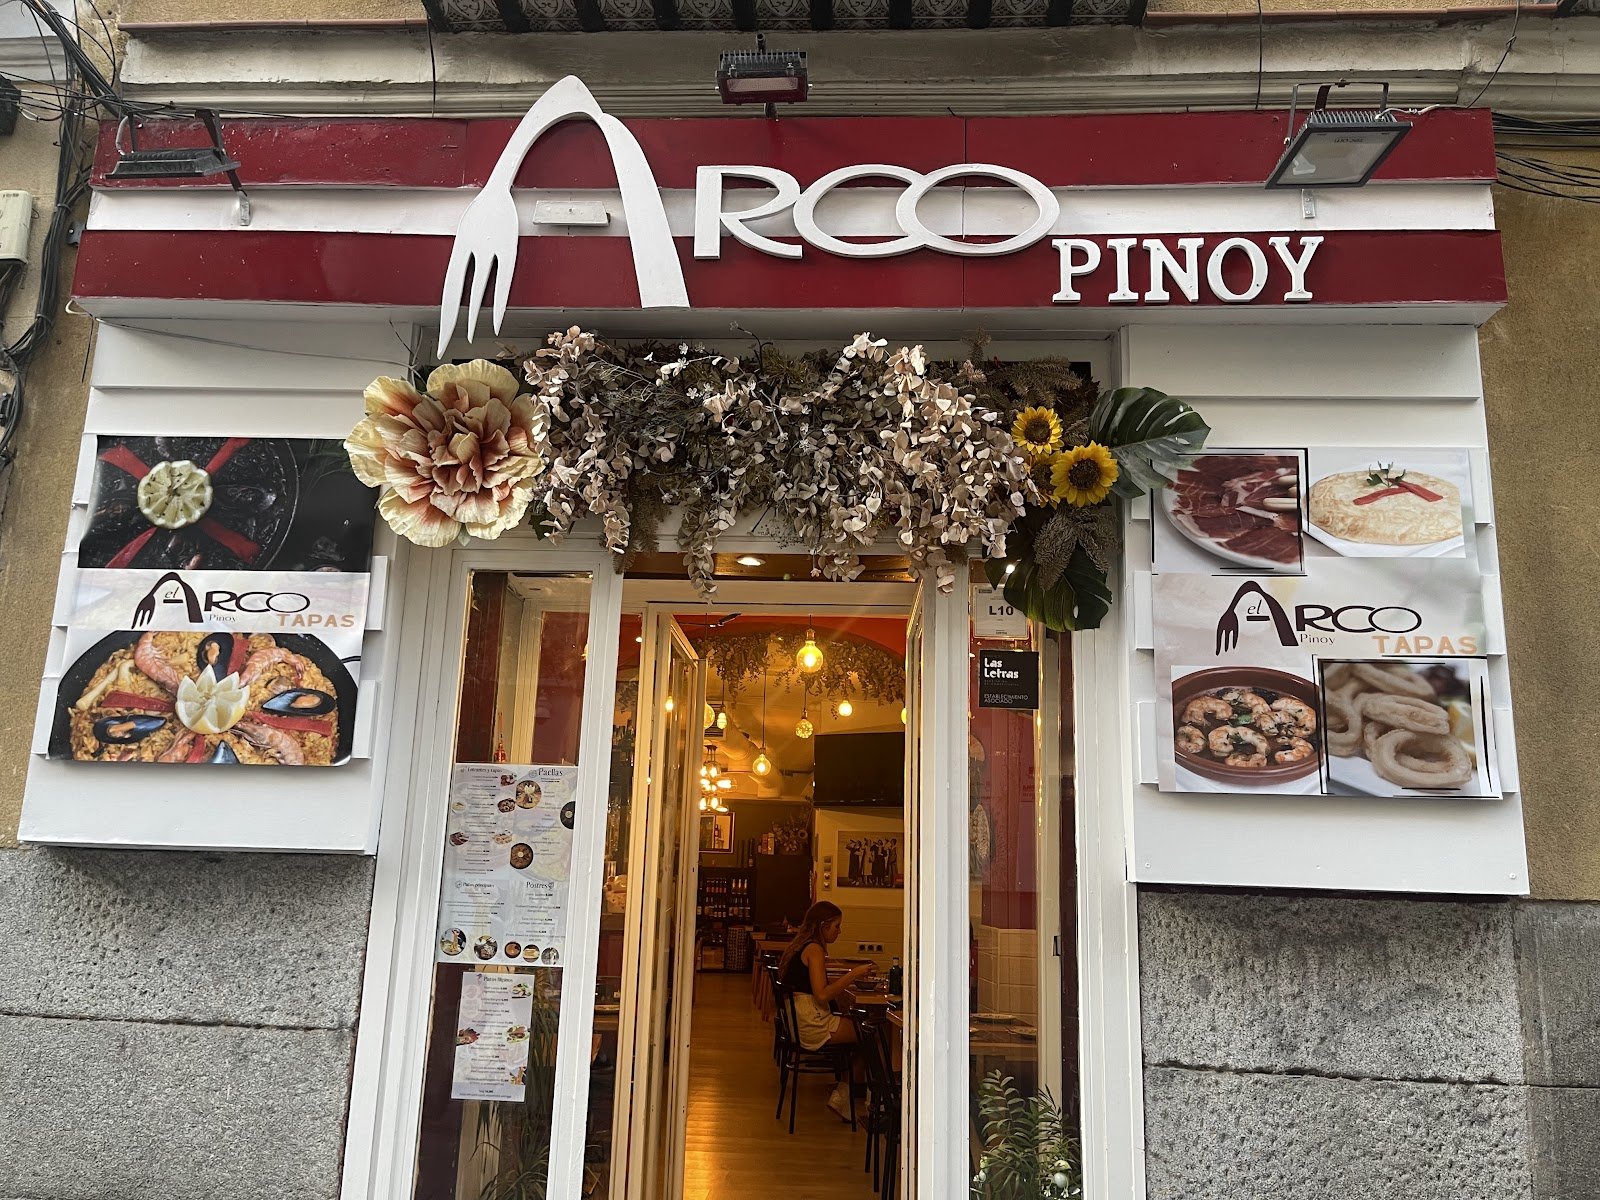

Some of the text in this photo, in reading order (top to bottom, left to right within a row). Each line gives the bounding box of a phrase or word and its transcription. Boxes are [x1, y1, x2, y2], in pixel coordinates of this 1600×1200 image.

[1051, 235, 1325, 303] PINOY
[164, 586, 178, 599] el
[989, 605, 1014, 616] L10
[1247, 599, 1262, 615] el
[208, 613, 236, 623] Pinoy
[277, 613, 355, 628] TAPAS
[1299, 633, 1336, 646] Pinoy
[1371, 635, 1478, 655] TAPAS
[984, 657, 1003, 668] Las
[984, 668, 1019, 679] Letras
[983, 693, 1029, 701] ESTABLECIMIENTO
[538, 767, 563, 777] Paellas
[526, 881, 548, 889] Postres
